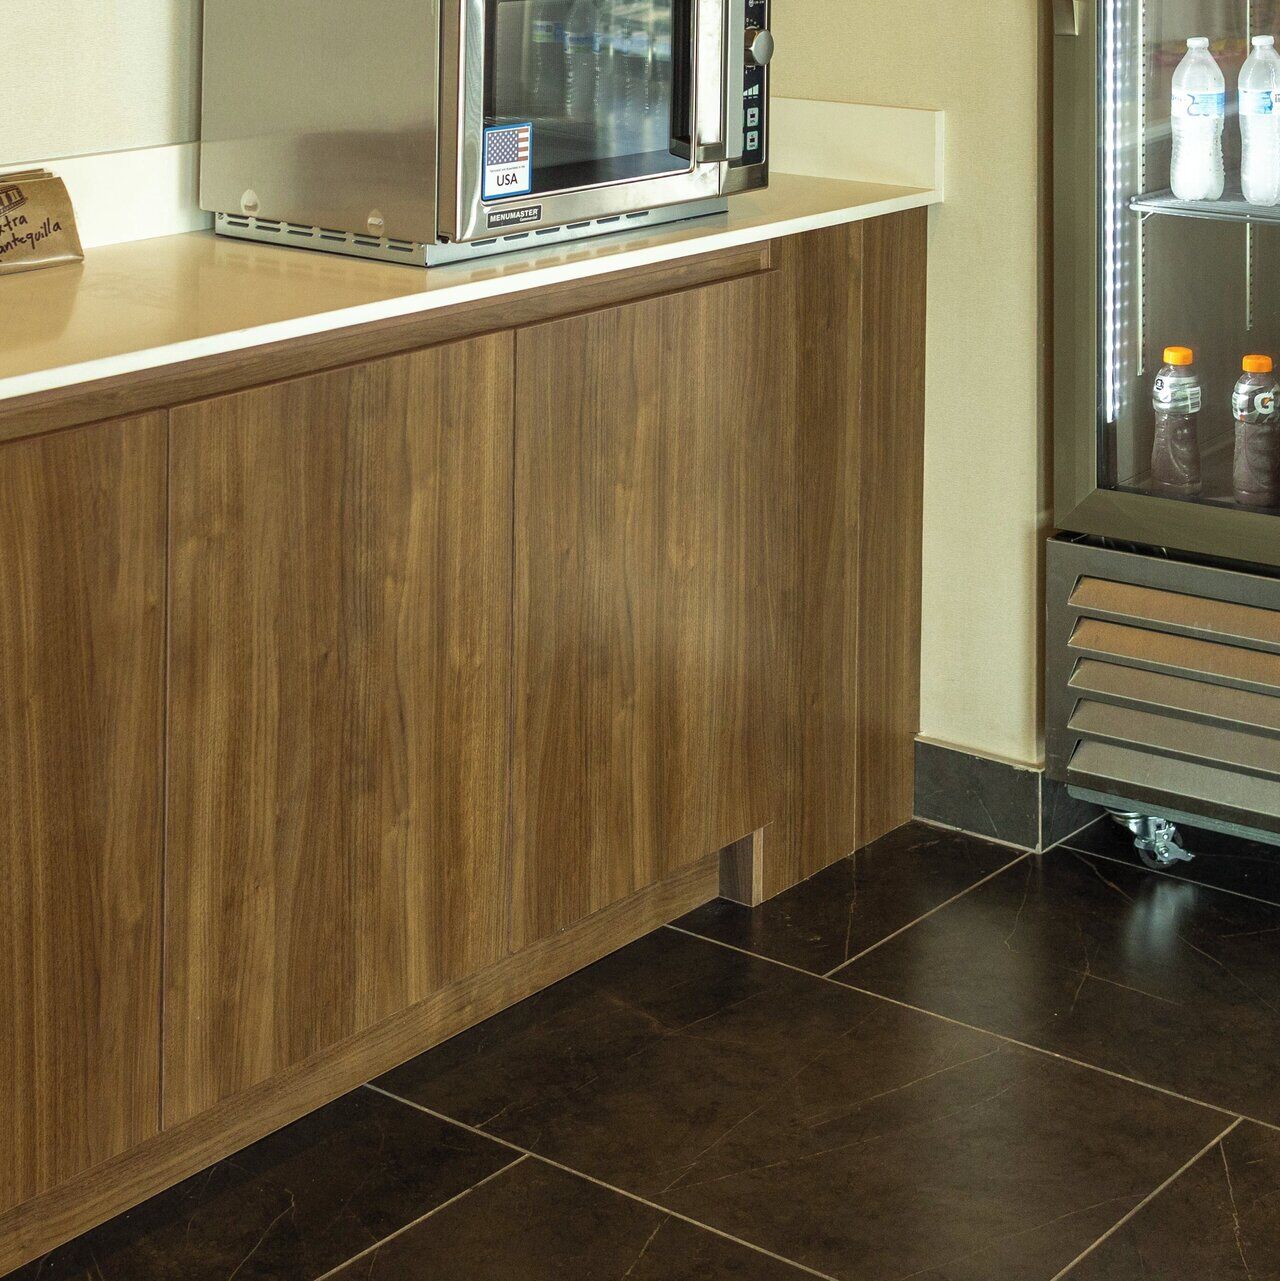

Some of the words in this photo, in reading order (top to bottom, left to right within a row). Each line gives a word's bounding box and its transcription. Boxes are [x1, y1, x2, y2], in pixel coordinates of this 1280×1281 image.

[496, 173, 518, 187] USA
[489, 208, 539, 223] MENUMASTER
[1254, 392, 1275, 415] G
